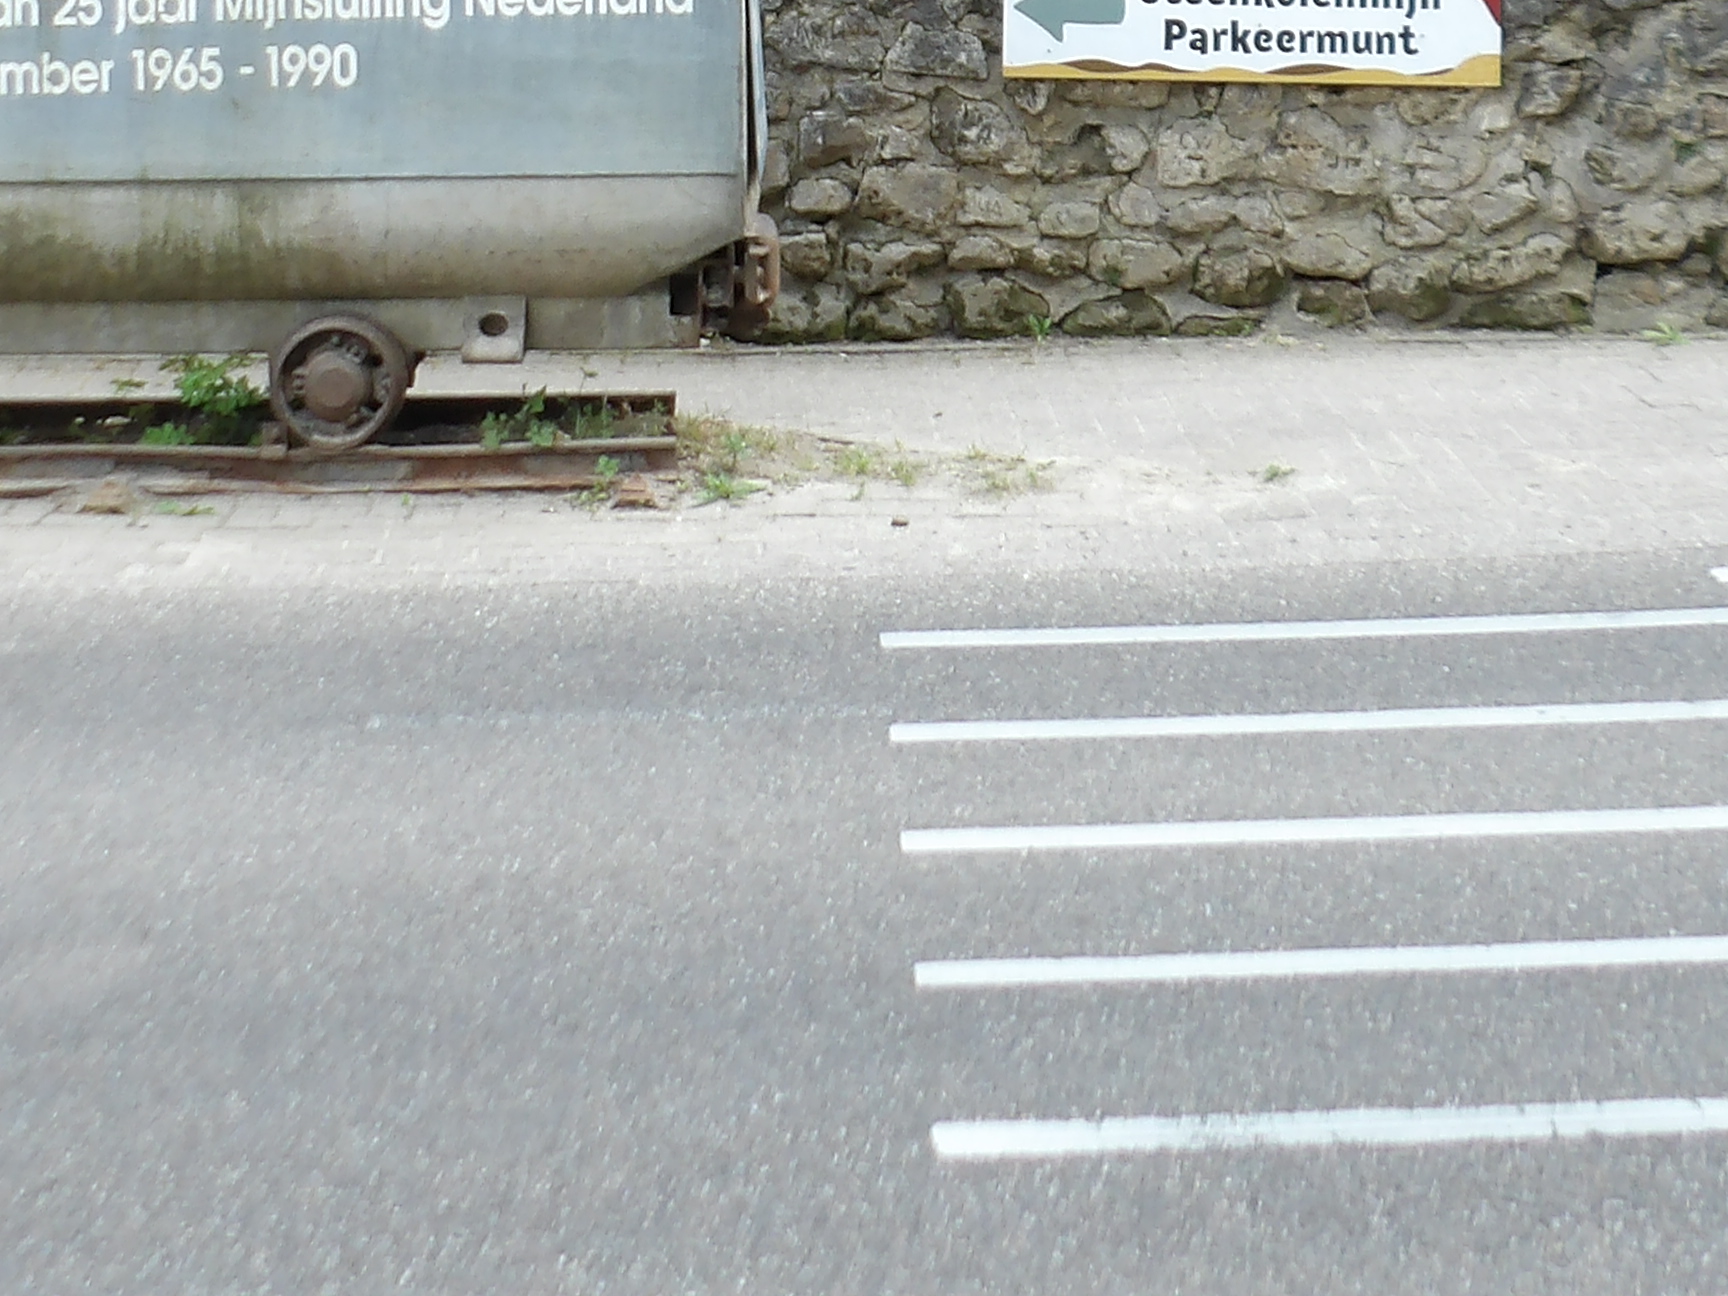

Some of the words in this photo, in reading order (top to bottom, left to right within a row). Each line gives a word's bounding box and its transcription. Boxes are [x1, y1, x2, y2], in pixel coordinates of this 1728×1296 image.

[1162, 18, 1419, 56] Parkeermunt
[130, 47, 224, 92] 1965
[265, 43, 359, 89] 1990
